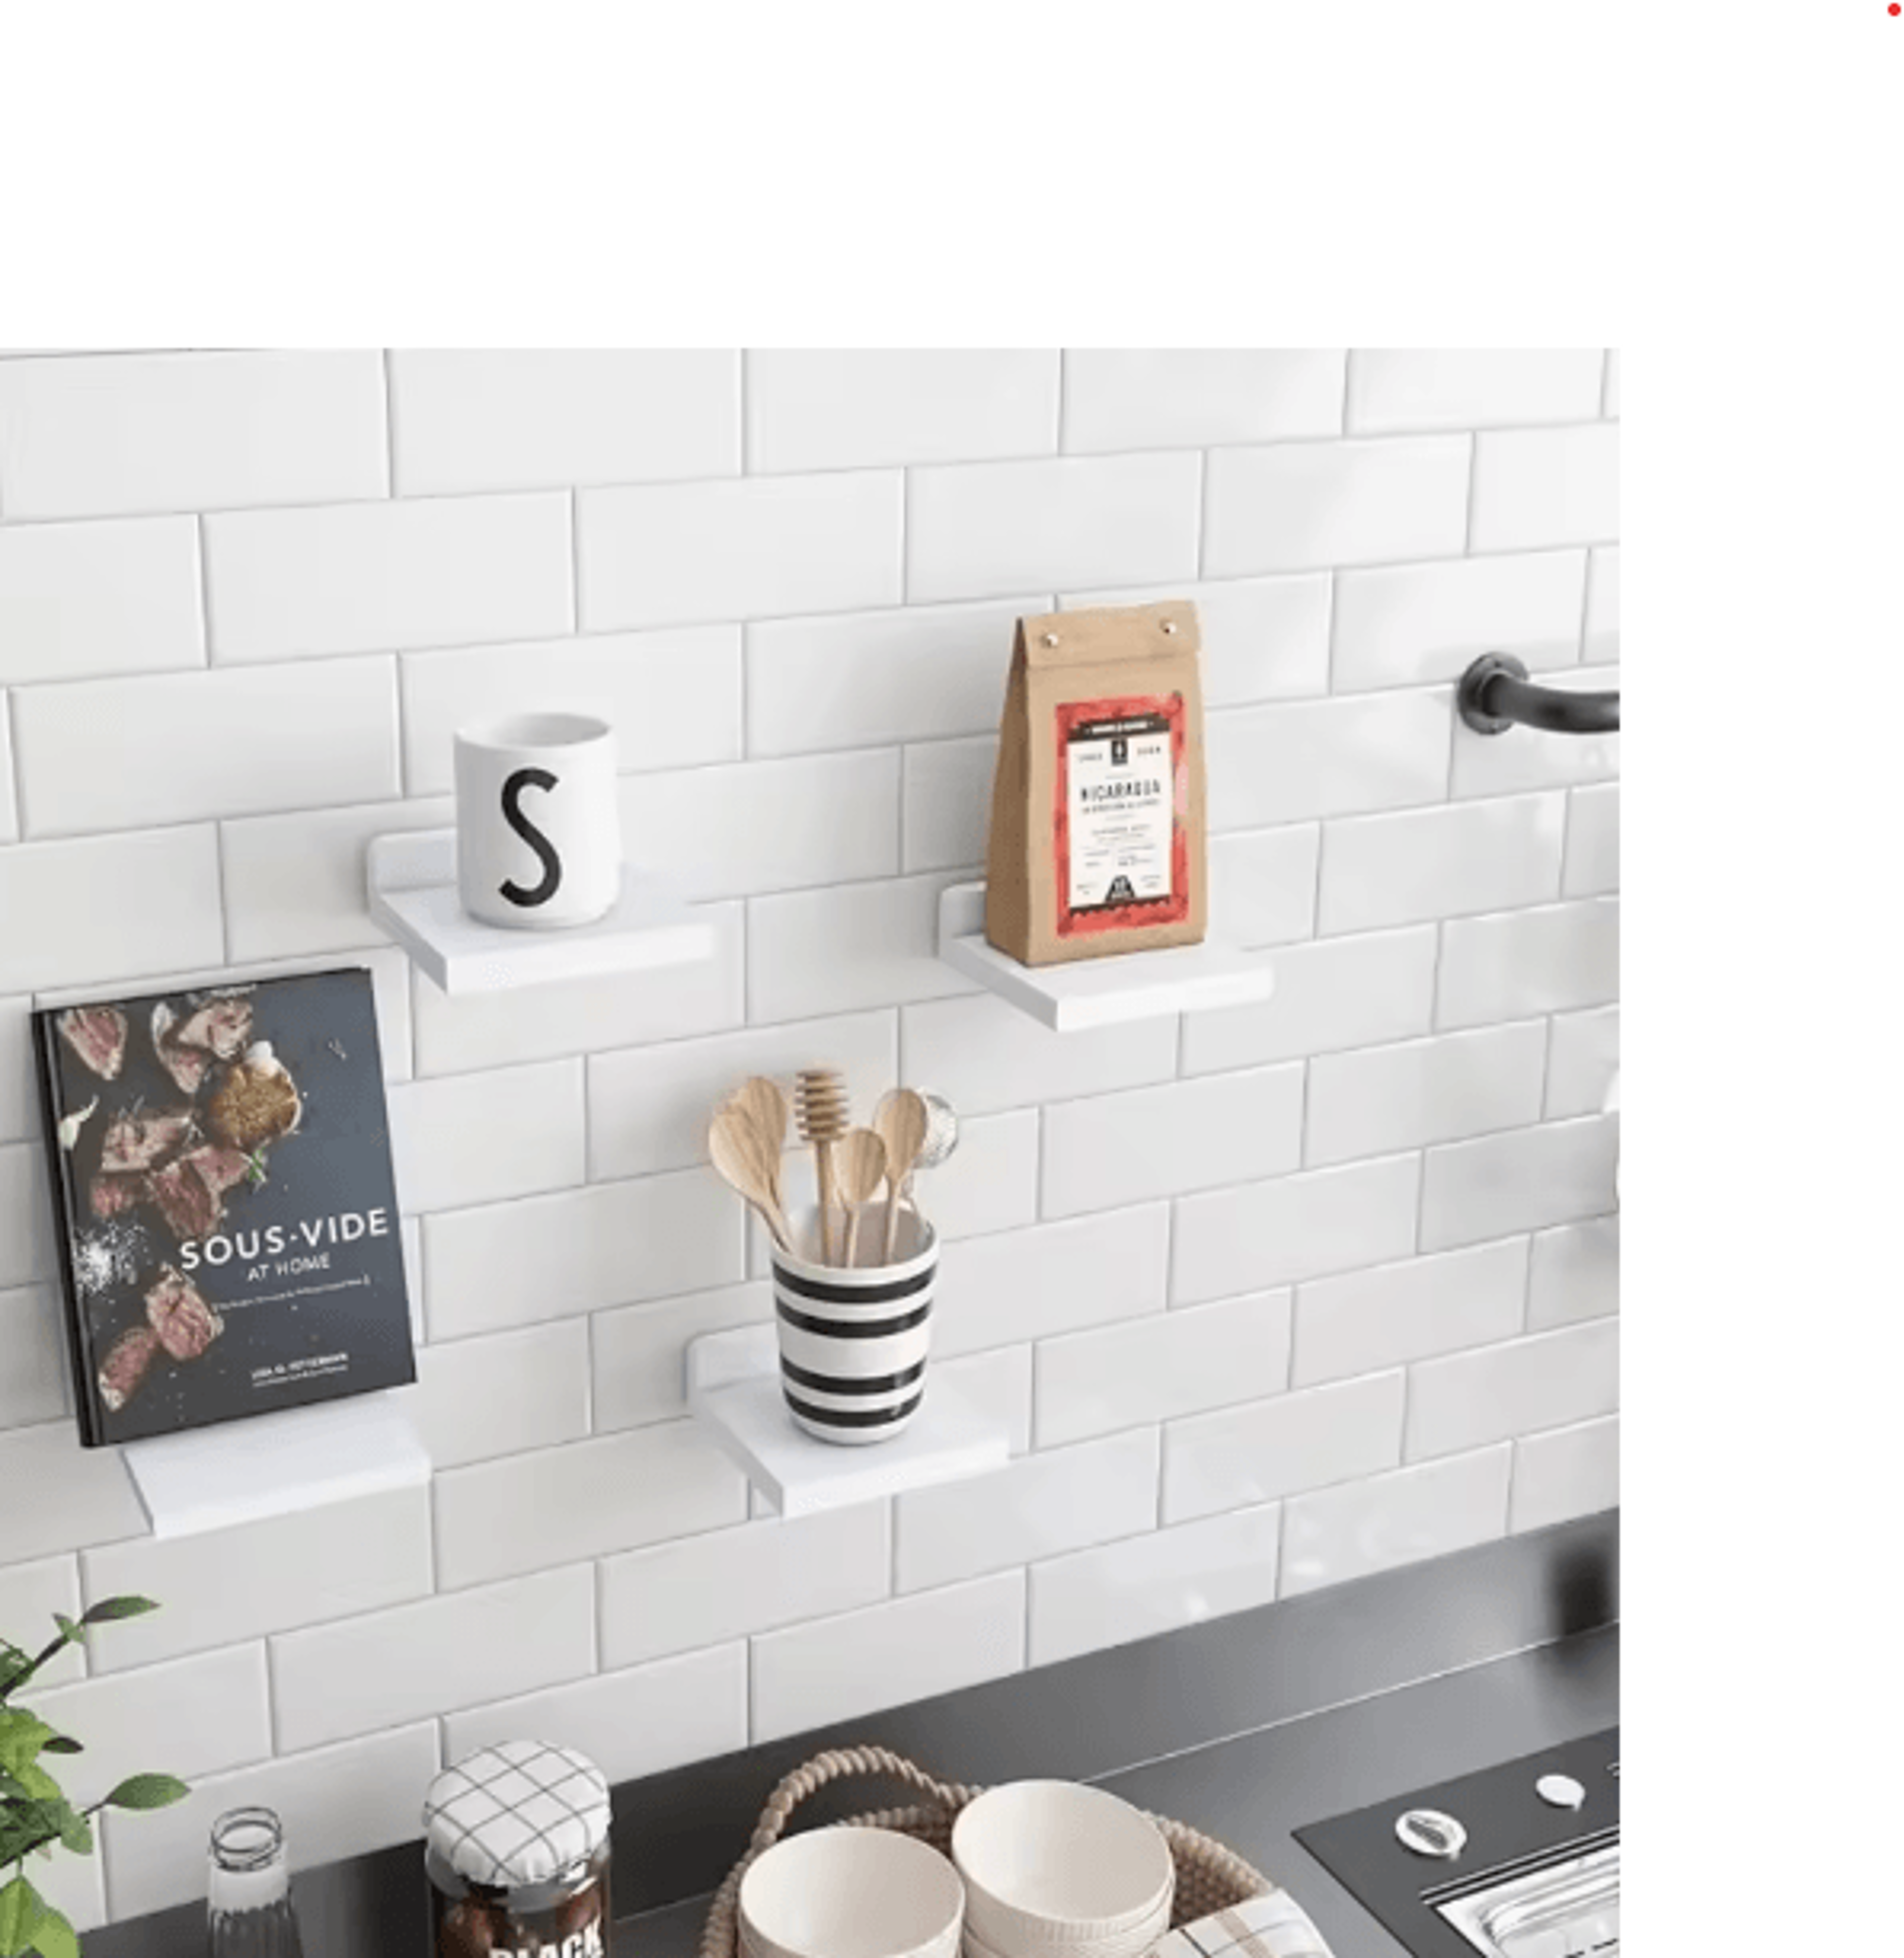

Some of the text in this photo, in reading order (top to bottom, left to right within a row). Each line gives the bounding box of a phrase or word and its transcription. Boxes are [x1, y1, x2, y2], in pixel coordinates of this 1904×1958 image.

[498, 767, 561, 907] S
[247, 1251, 331, 1282] AT HOME
